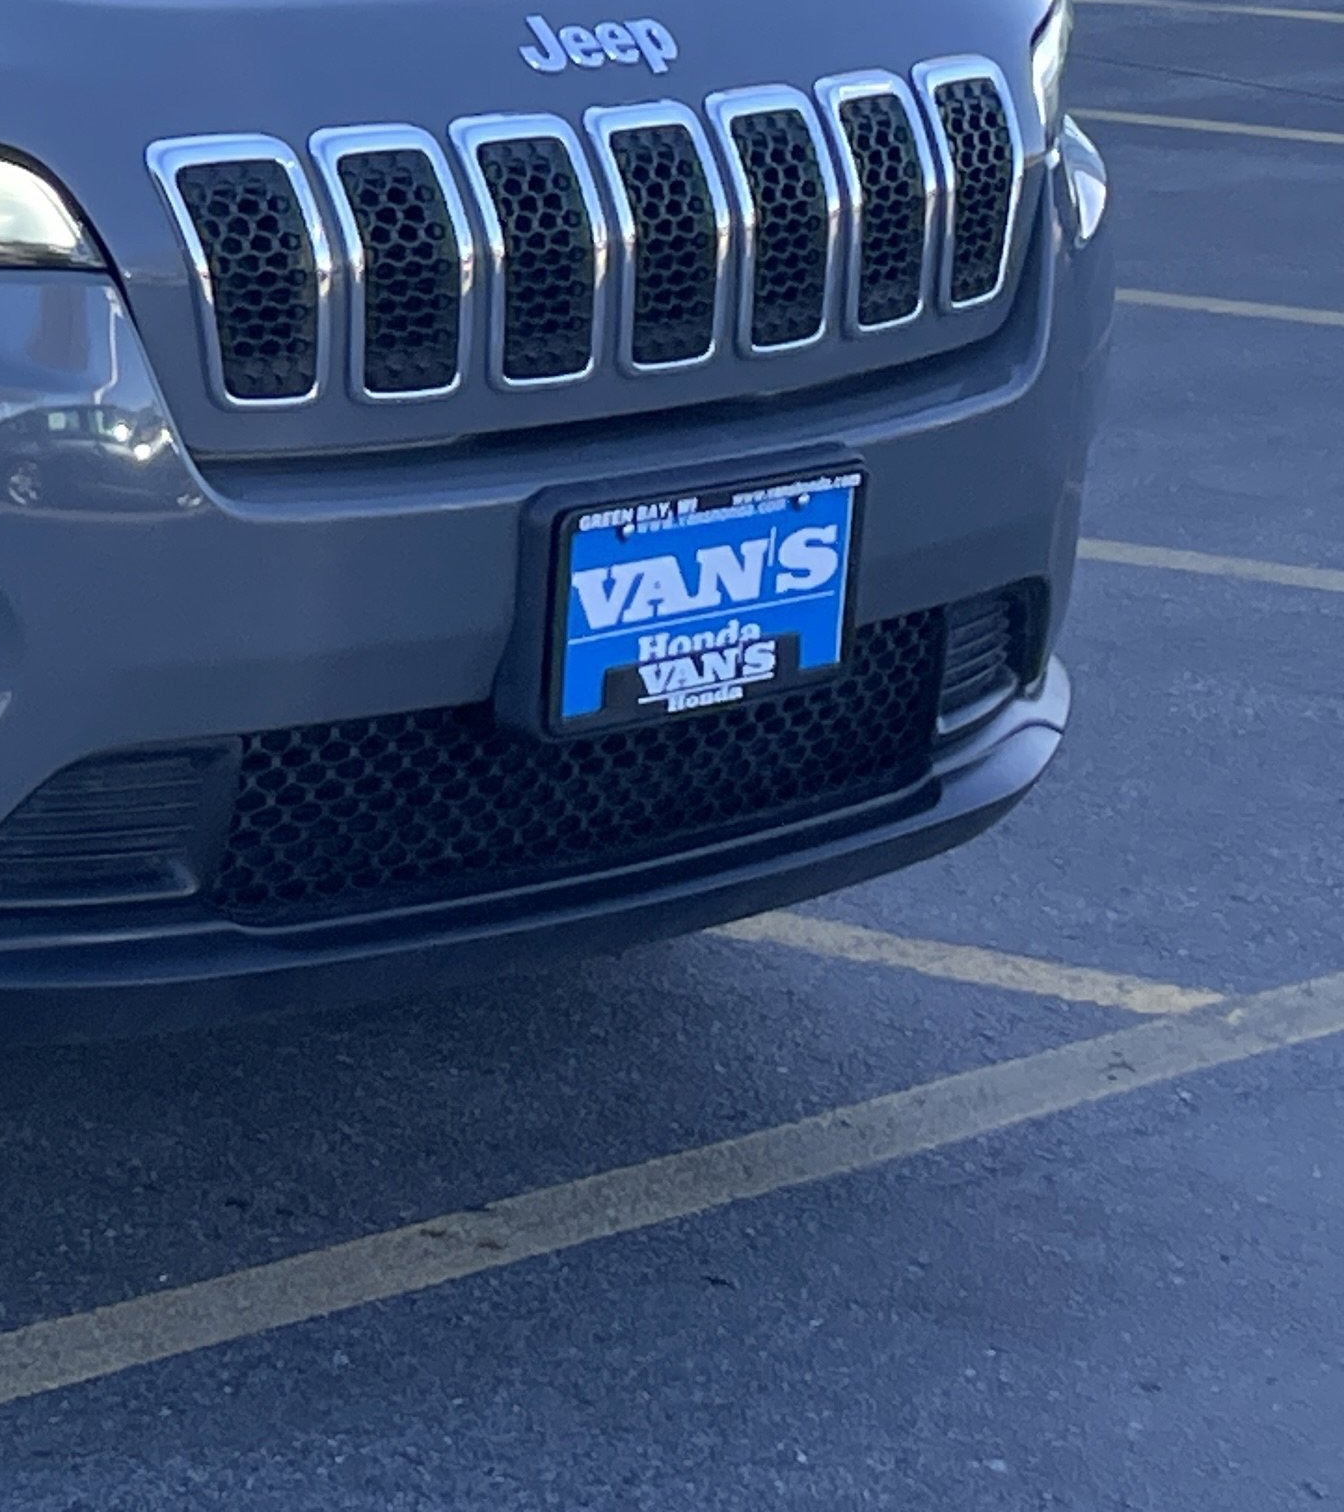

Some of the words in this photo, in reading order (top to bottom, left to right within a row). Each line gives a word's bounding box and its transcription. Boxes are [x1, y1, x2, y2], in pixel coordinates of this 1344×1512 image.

[519, 14, 679, 75] Jeep
[579, 509, 635, 532] GREEN
[571, 524, 839, 630] VAN'S
[638, 619, 762, 662] Honda
[638, 640, 776, 696] VAN'S
[667, 685, 744, 713] Honda
